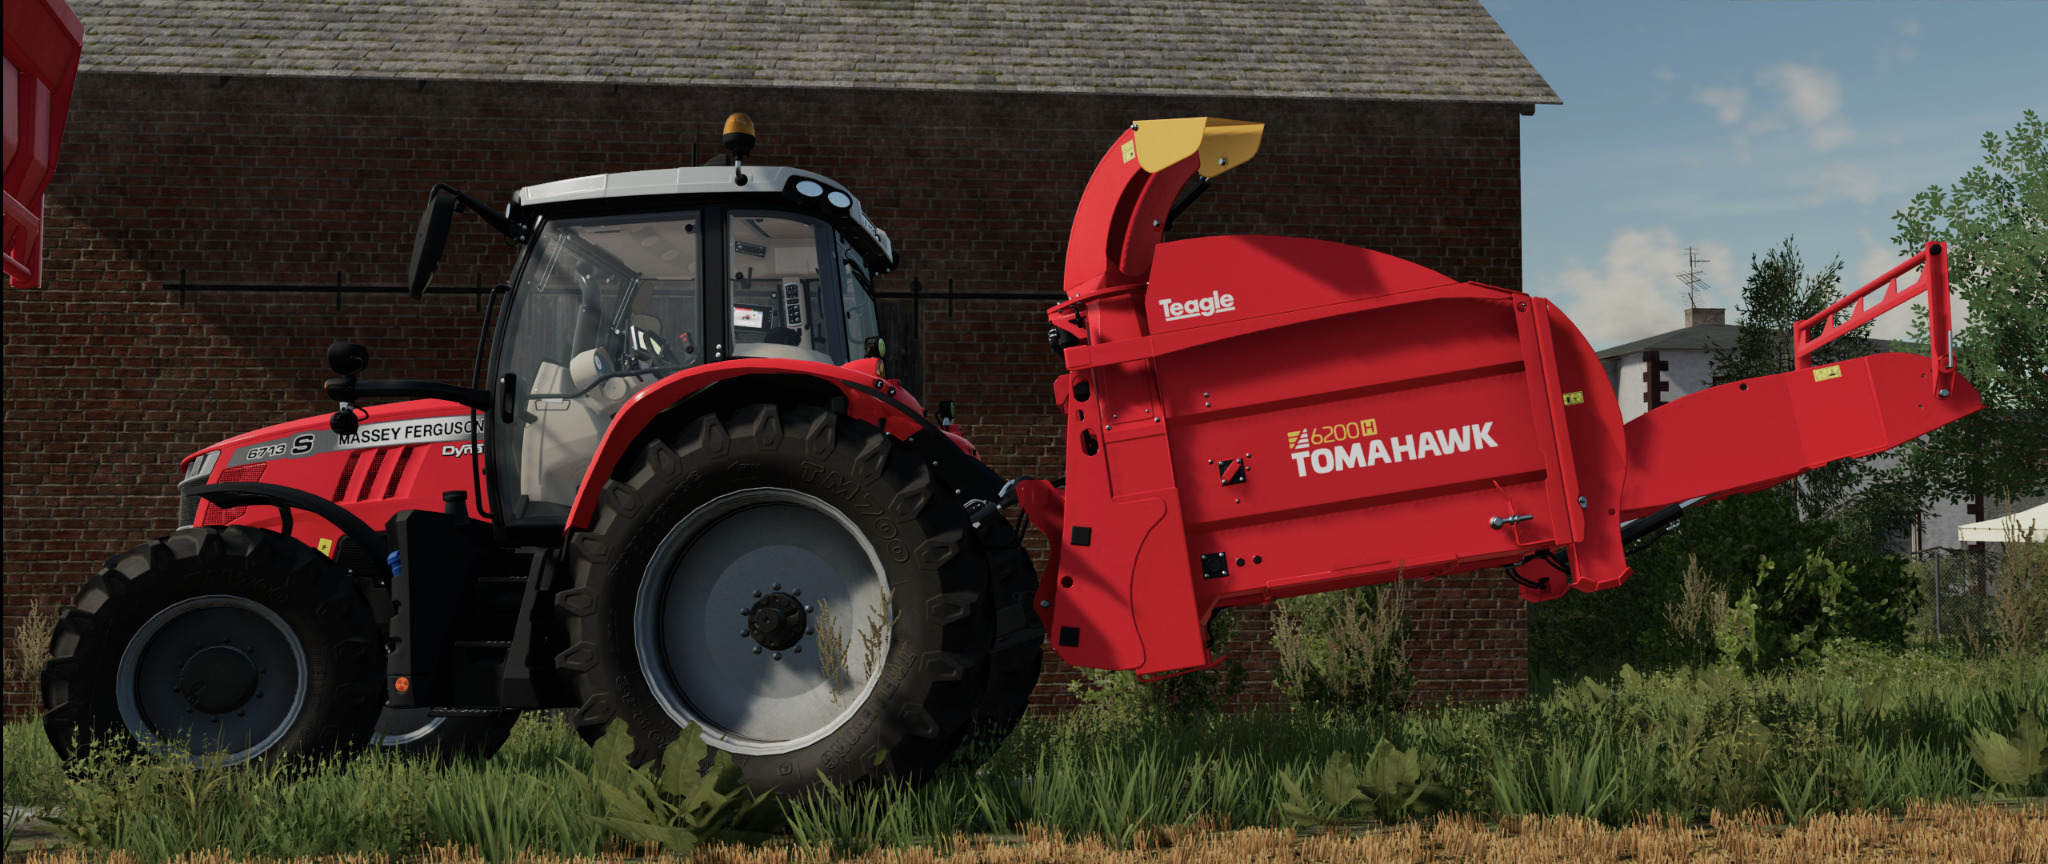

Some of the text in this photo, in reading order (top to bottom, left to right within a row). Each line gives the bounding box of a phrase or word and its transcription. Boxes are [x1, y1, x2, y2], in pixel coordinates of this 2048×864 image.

[1159, 291, 1235, 320] Teagle
[247, 434, 315, 461] 6713 S
[338, 428, 401, 446] MASSEY
[1292, 422, 1497, 476] TOMAHAWK
